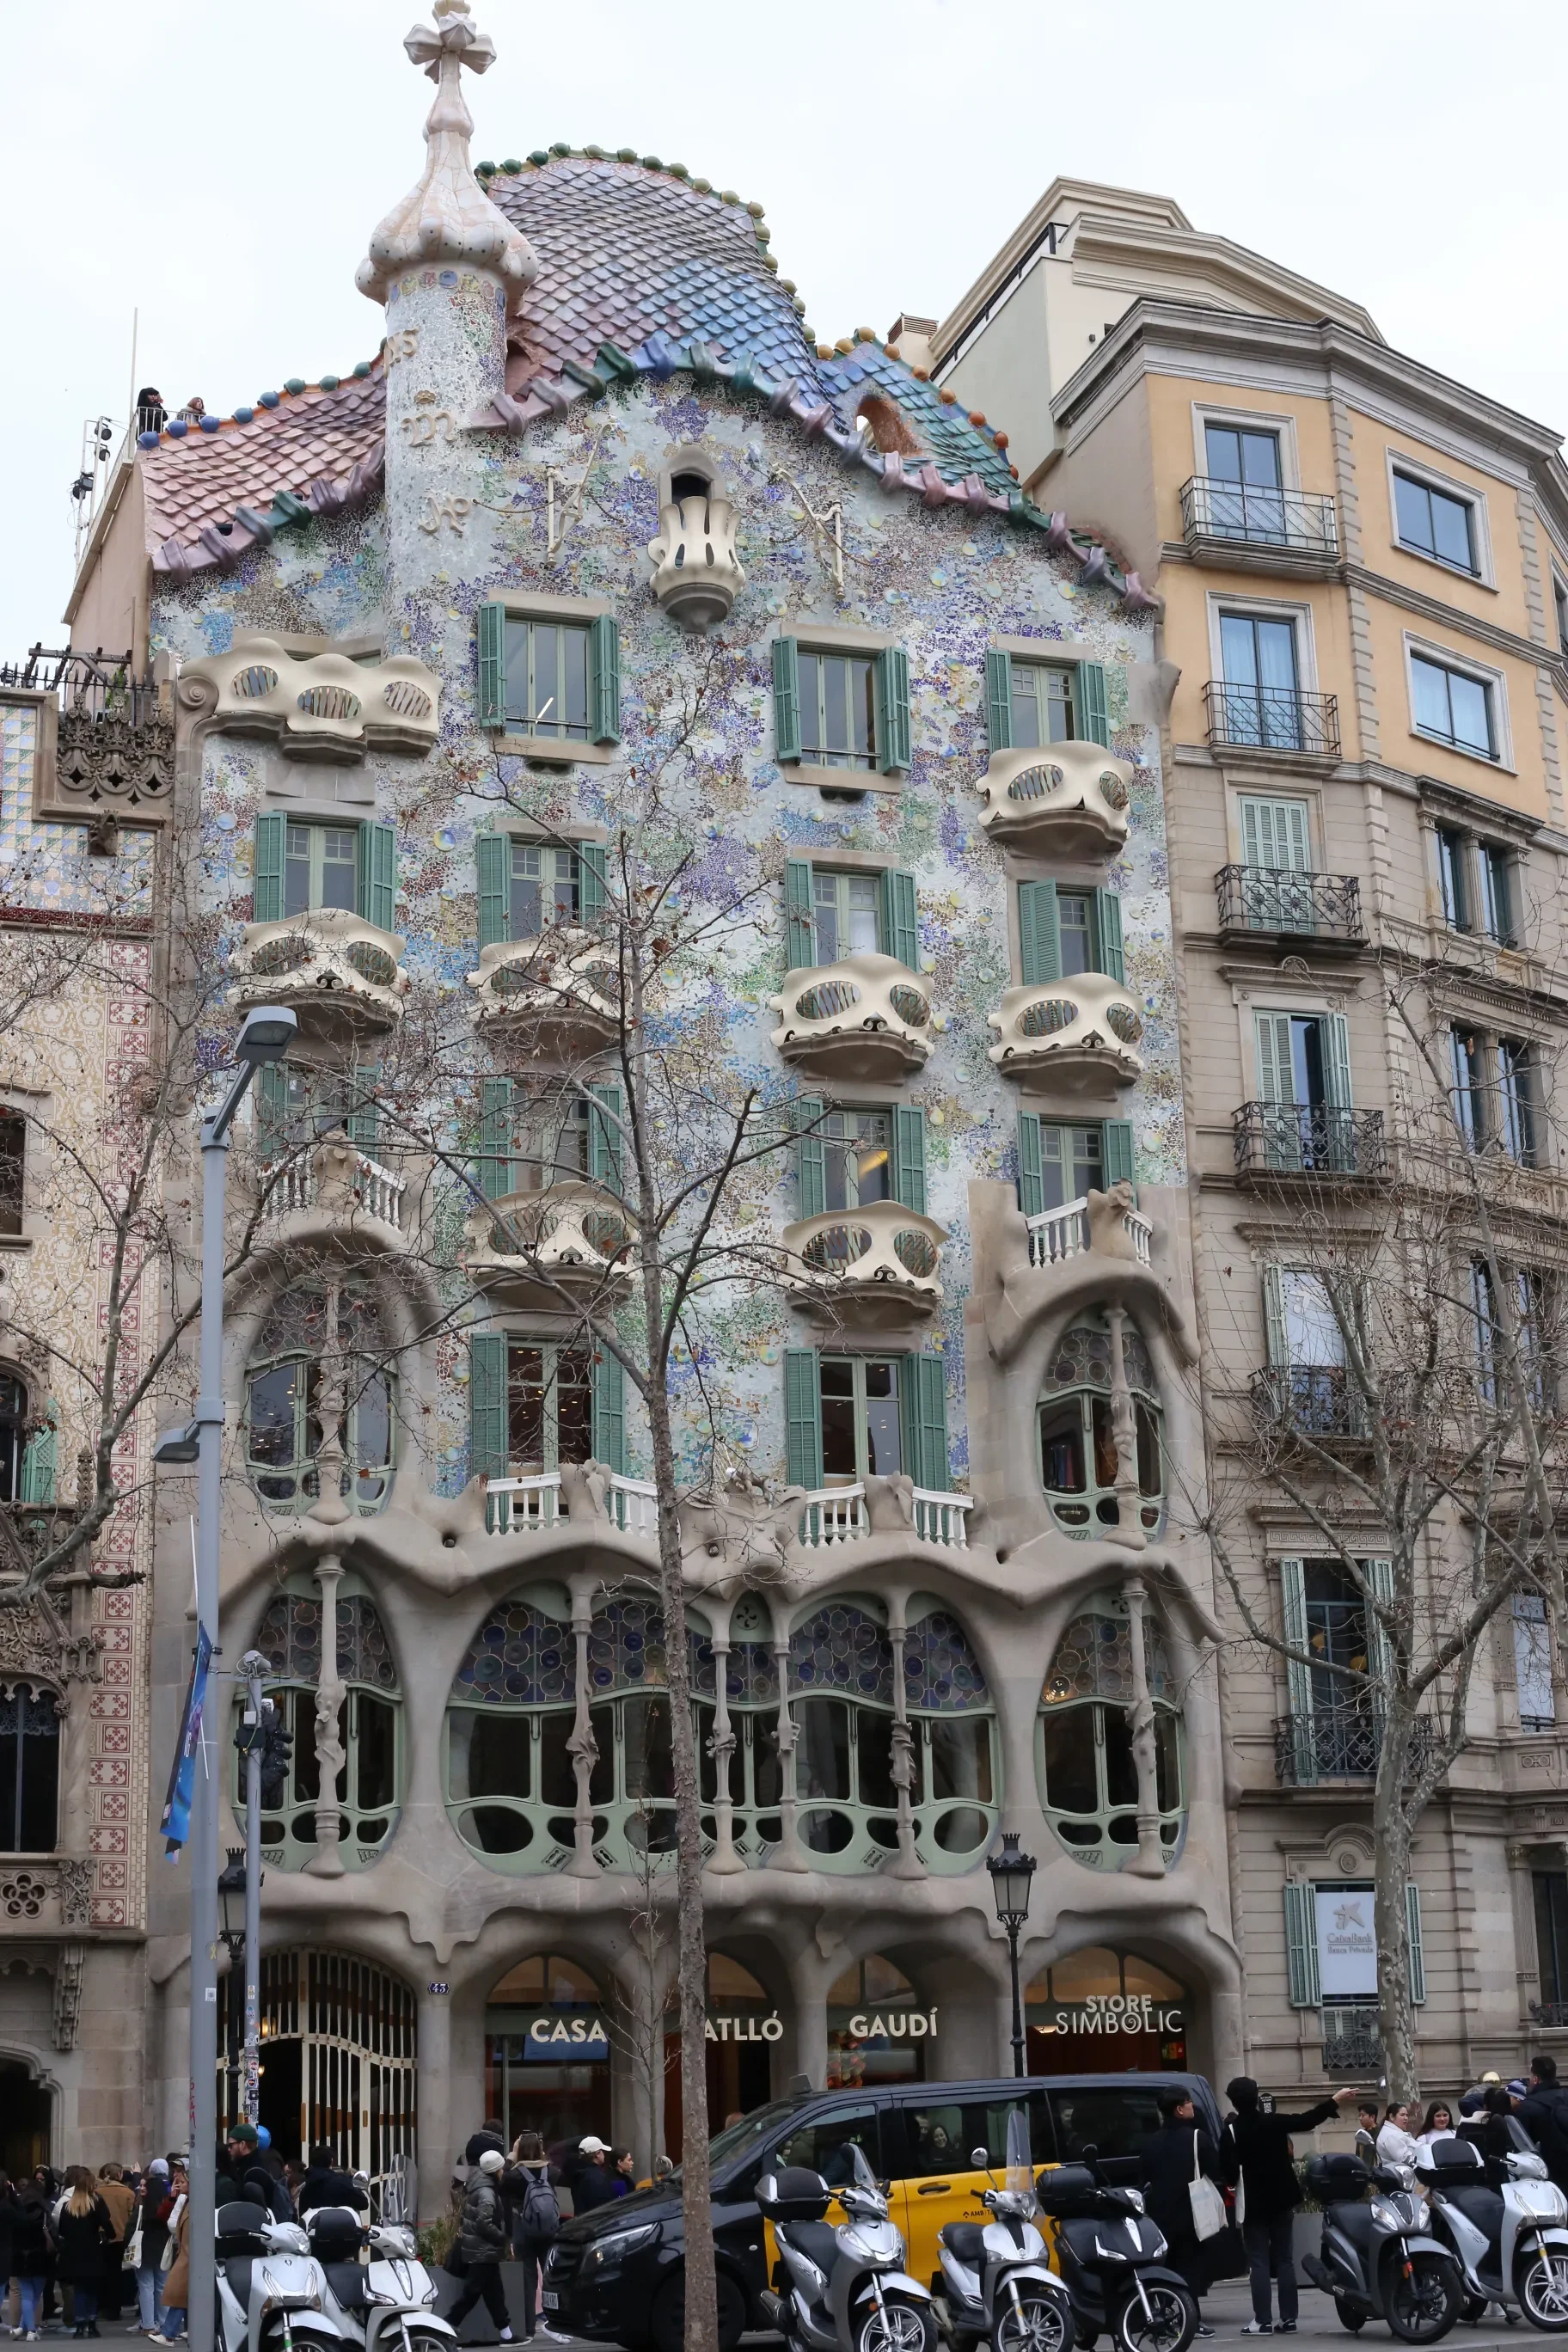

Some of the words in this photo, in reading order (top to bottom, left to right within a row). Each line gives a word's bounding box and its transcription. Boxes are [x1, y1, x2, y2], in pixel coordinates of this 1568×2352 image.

[1327, 1932, 1373, 1943] CaixaBank
[432, 1983, 446, 1994] 43
[1086, 1994, 1153, 2012] STORE
[530, 2019, 608, 2043] CASA
[705, 2010, 783, 2042] ATLLÓ
[849, 2006, 938, 2037] GAUDÍ
